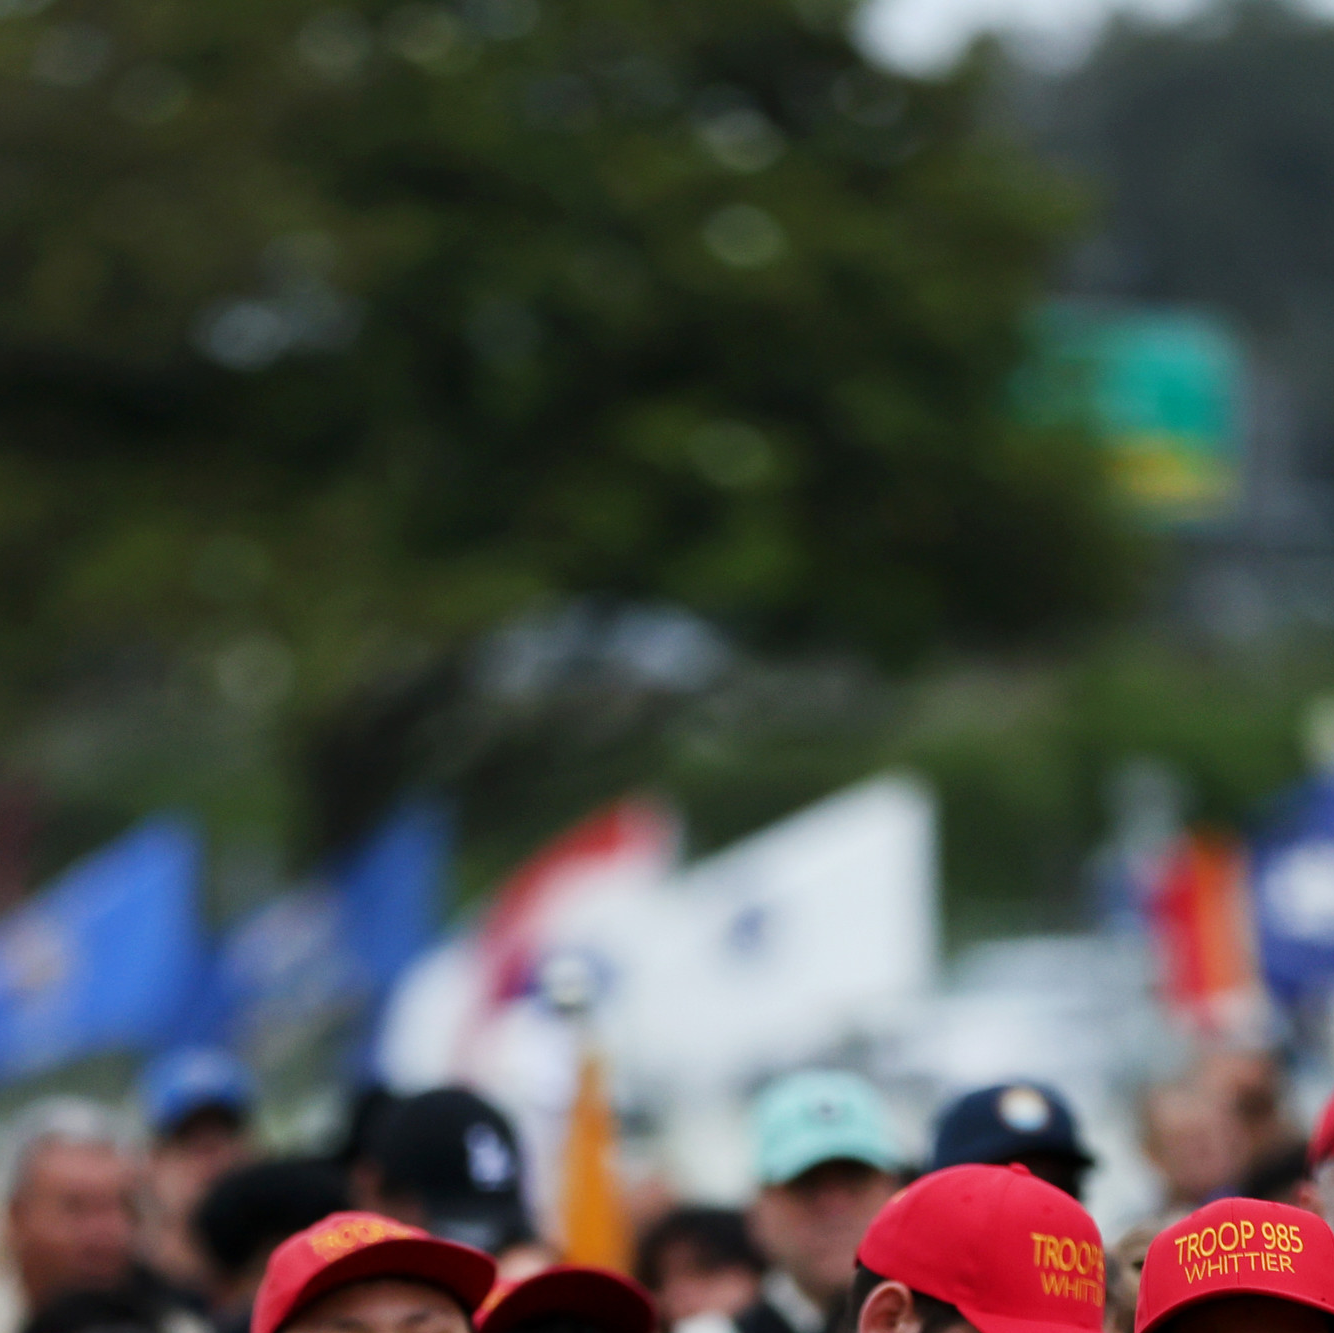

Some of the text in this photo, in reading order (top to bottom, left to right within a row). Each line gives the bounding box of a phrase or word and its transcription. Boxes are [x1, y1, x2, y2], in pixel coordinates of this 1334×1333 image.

[1174, 1219, 1304, 1265] TROOP 985
[1184, 1251, 1296, 1285] WHITTIER
